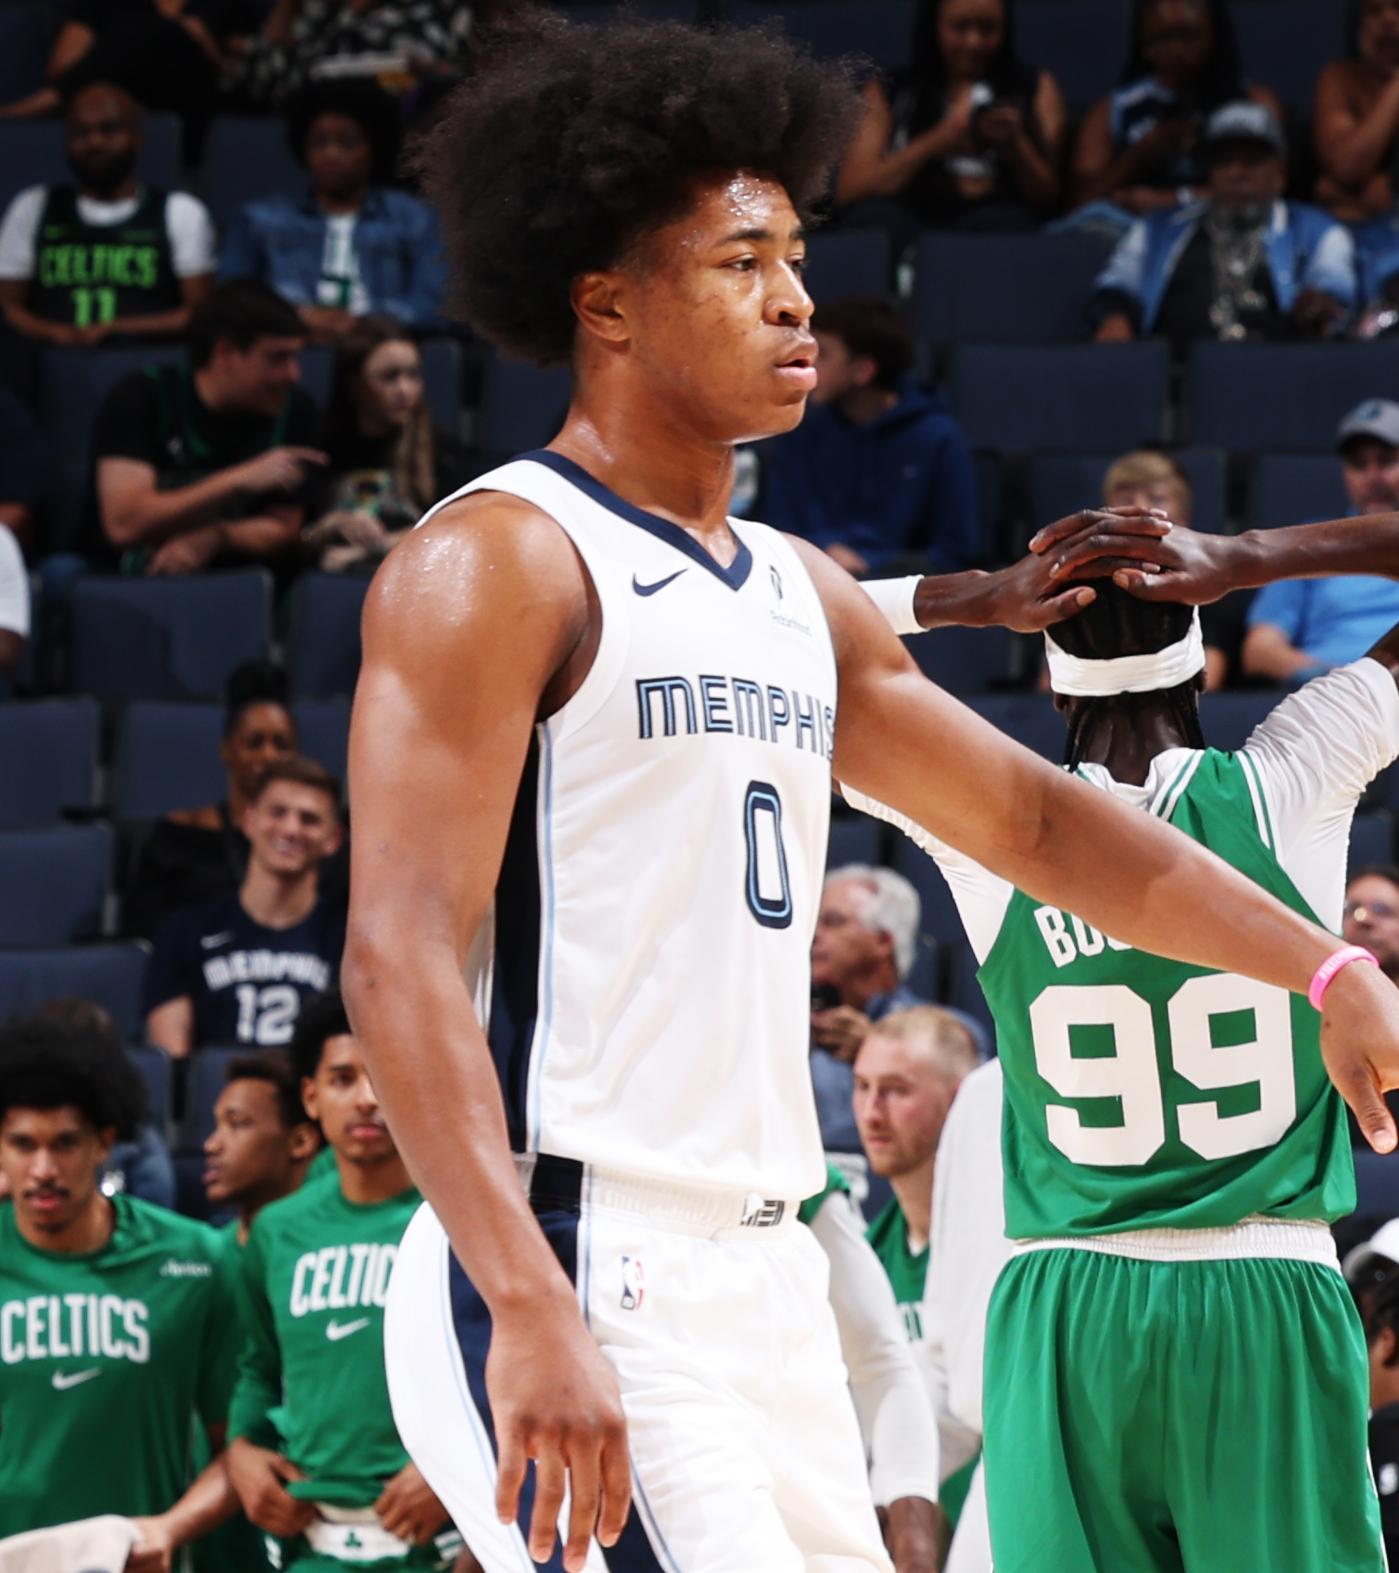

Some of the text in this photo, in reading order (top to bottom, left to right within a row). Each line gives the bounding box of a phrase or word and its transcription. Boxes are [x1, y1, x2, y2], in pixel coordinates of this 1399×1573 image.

[70, 287, 117, 329] 11
[744, 779, 793, 930] 0
[1033, 905, 1133, 968] BO
[236, 983, 300, 1045] 12
[1029, 972, 1297, 1165] 99
[290, 1243, 399, 1318] CELTIC
[0, 1293, 150, 1364] CELTICS
